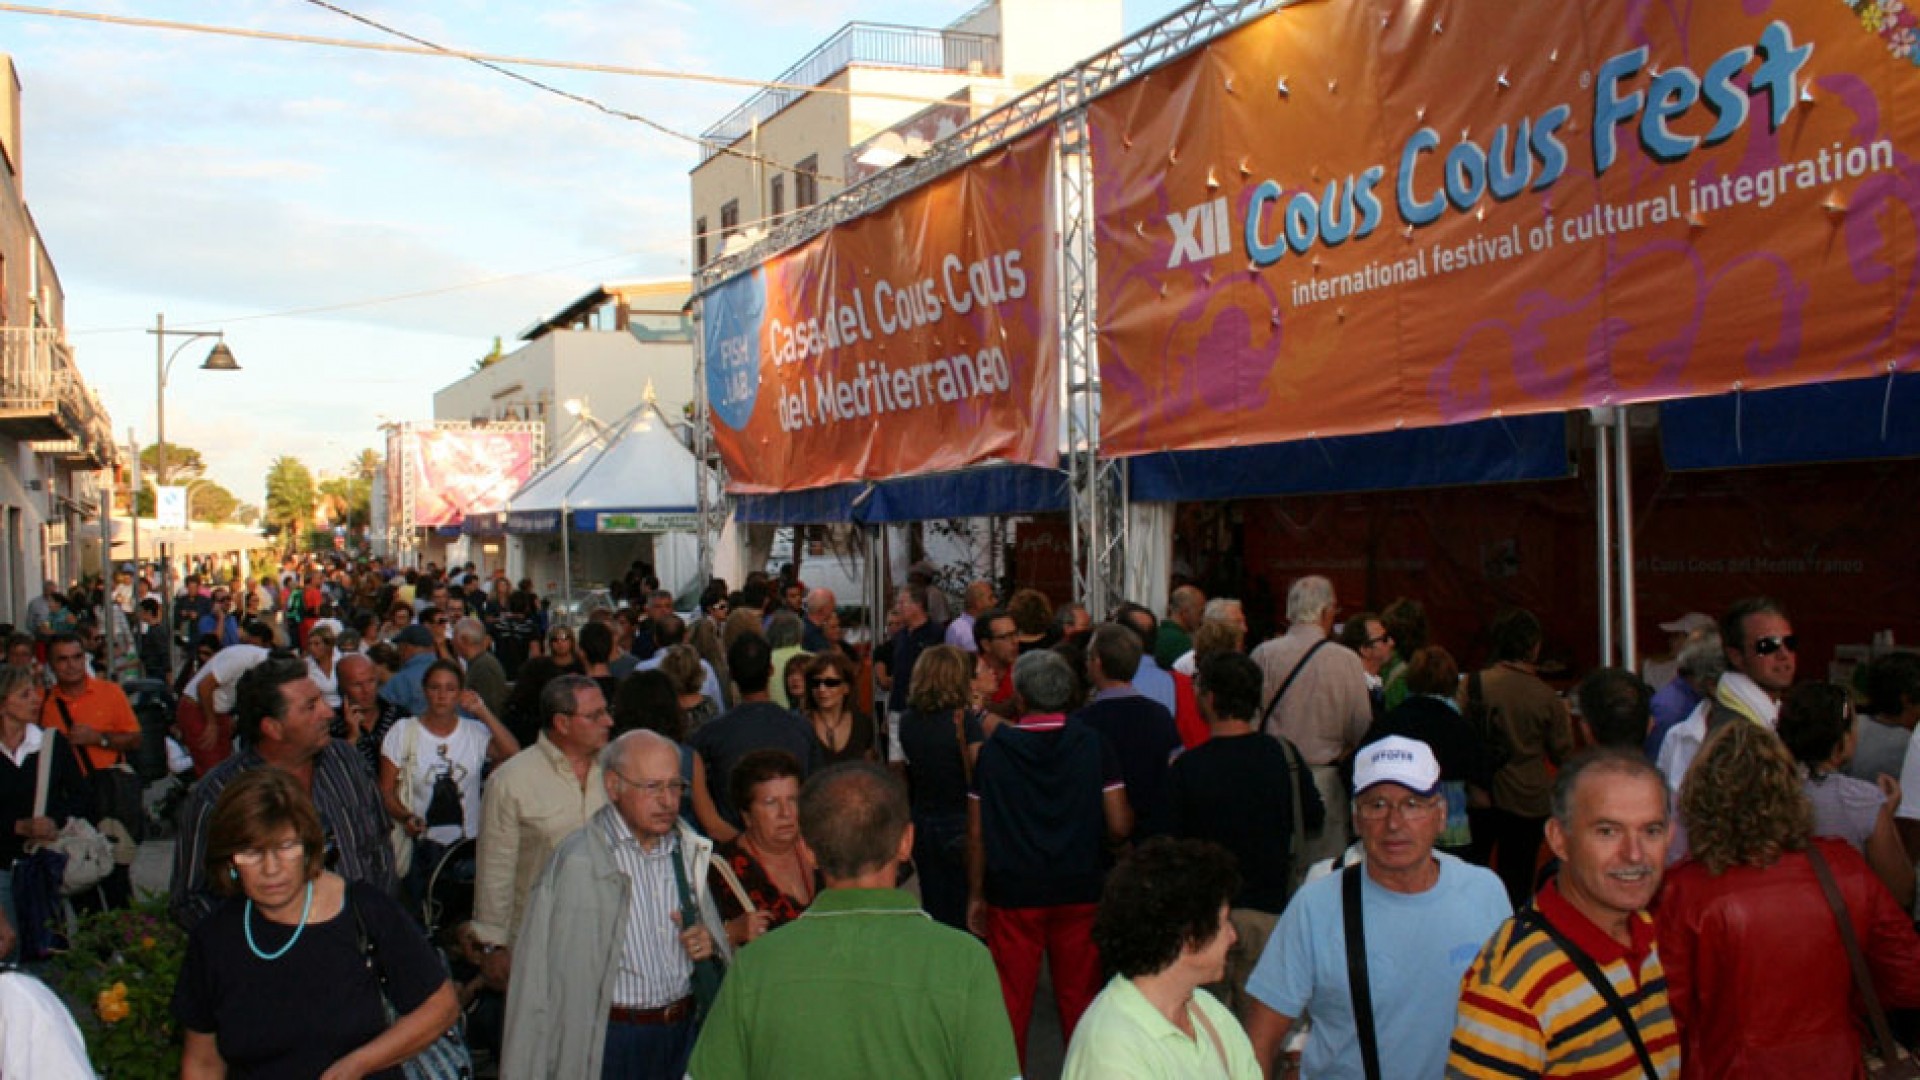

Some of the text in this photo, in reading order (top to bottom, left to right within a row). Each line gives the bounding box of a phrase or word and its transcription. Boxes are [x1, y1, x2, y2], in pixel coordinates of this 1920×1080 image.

[1166, 19, 1813, 268] XII Cous Cous Fest
[1292, 139, 1893, 307] international festival of cultural integration
[769, 249, 1026, 366] Casa del Cous Cous
[779, 347, 1010, 433] del Mediterraneo
